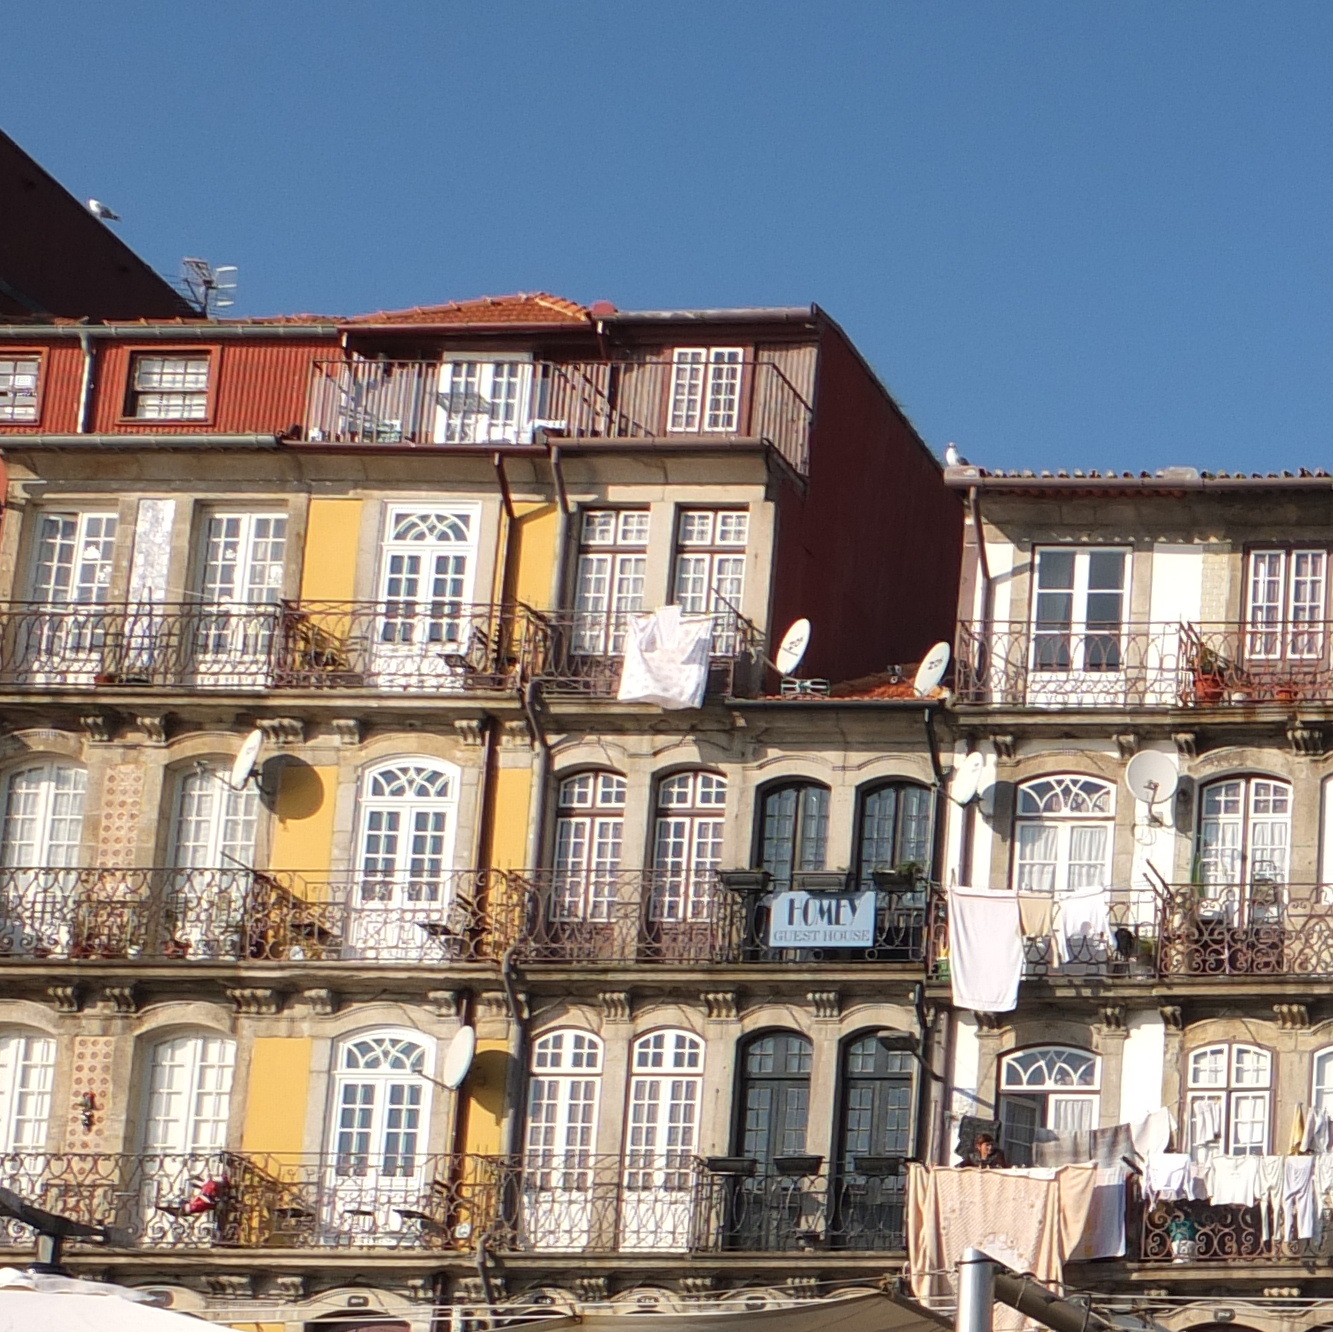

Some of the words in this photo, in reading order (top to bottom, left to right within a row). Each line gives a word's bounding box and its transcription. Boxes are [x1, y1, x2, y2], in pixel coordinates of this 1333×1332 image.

[788, 898, 863, 926] HOMEY
[773, 930, 820, 942] GUEST
[824, 929, 870, 942] HOUSE
